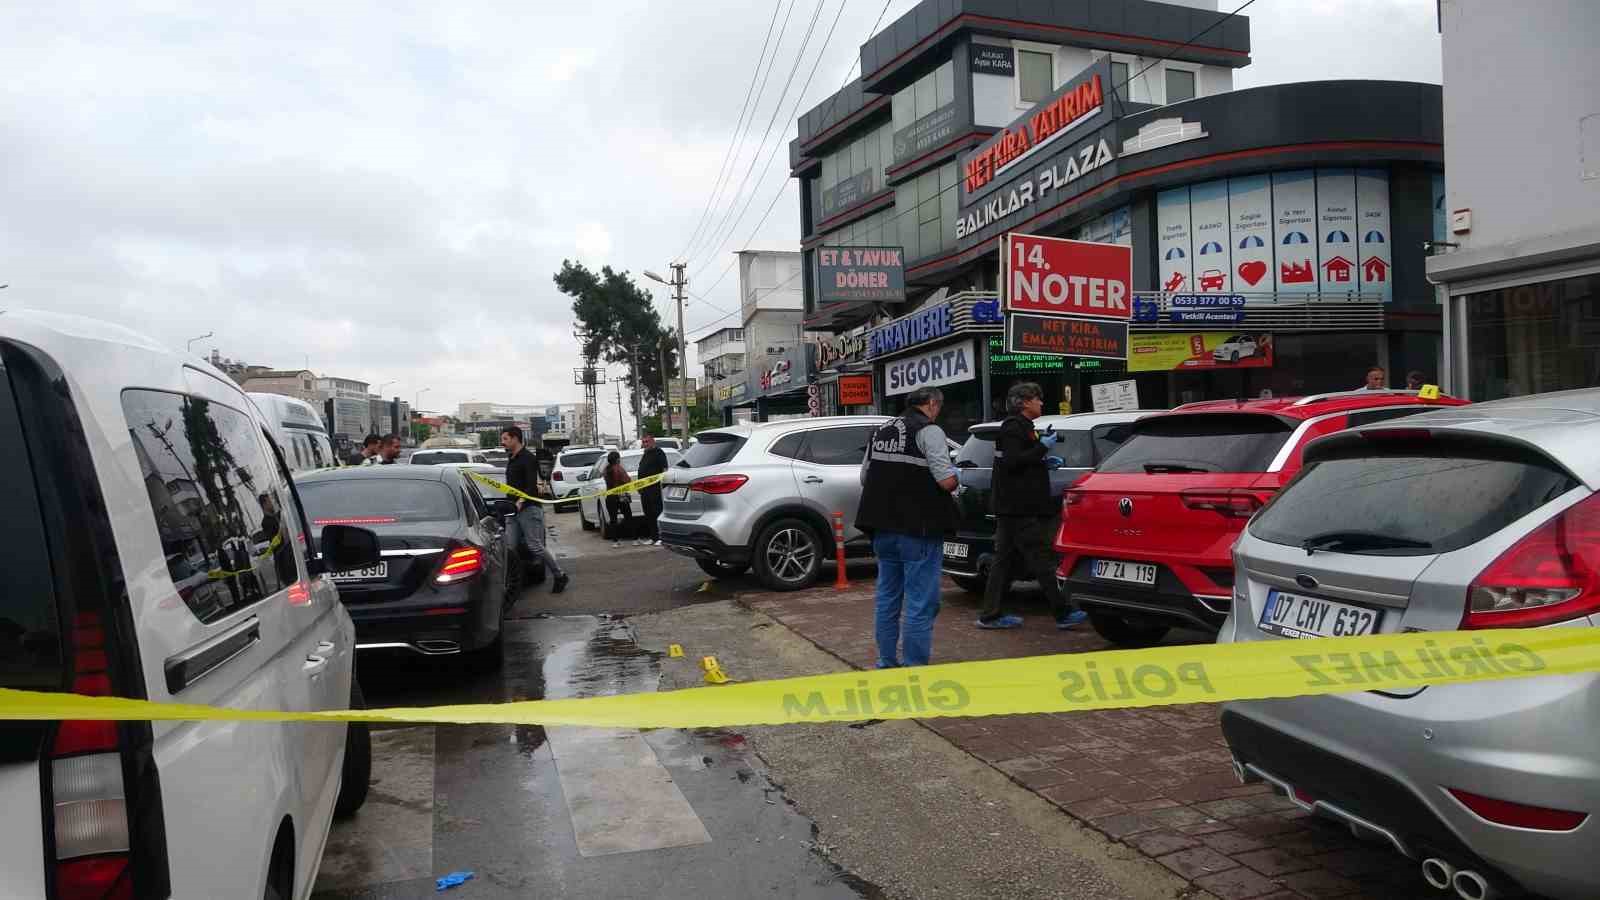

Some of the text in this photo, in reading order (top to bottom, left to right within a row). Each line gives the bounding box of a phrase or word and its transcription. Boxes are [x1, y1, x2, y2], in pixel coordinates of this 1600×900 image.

[992, 59, 1013, 69] KARA
[966, 74, 1104, 193] NET KİRA YATIRIM
[956, 138, 1114, 239] BALIKLAR PLAZA
[821, 249, 901, 267] ET & TAVUK
[1014, 242, 1051, 270] 14.
[836, 268, 888, 288] DÖNER
[1014, 270, 1127, 310] NOTER
[1174, 296, 1197, 305] 0533
[1200, 296, 1216, 305] 377
[1218, 296, 1230, 305] 00
[1041, 319, 1067, 332] NET
[1022, 331, 1065, 348] EMLAK
[1069, 335, 1120, 351] YATIRIM
[1097, 560, 1110, 577] 07
[1135, 565, 1155, 582] 119
[1272, 594, 1373, 637] 07 CHY 632
